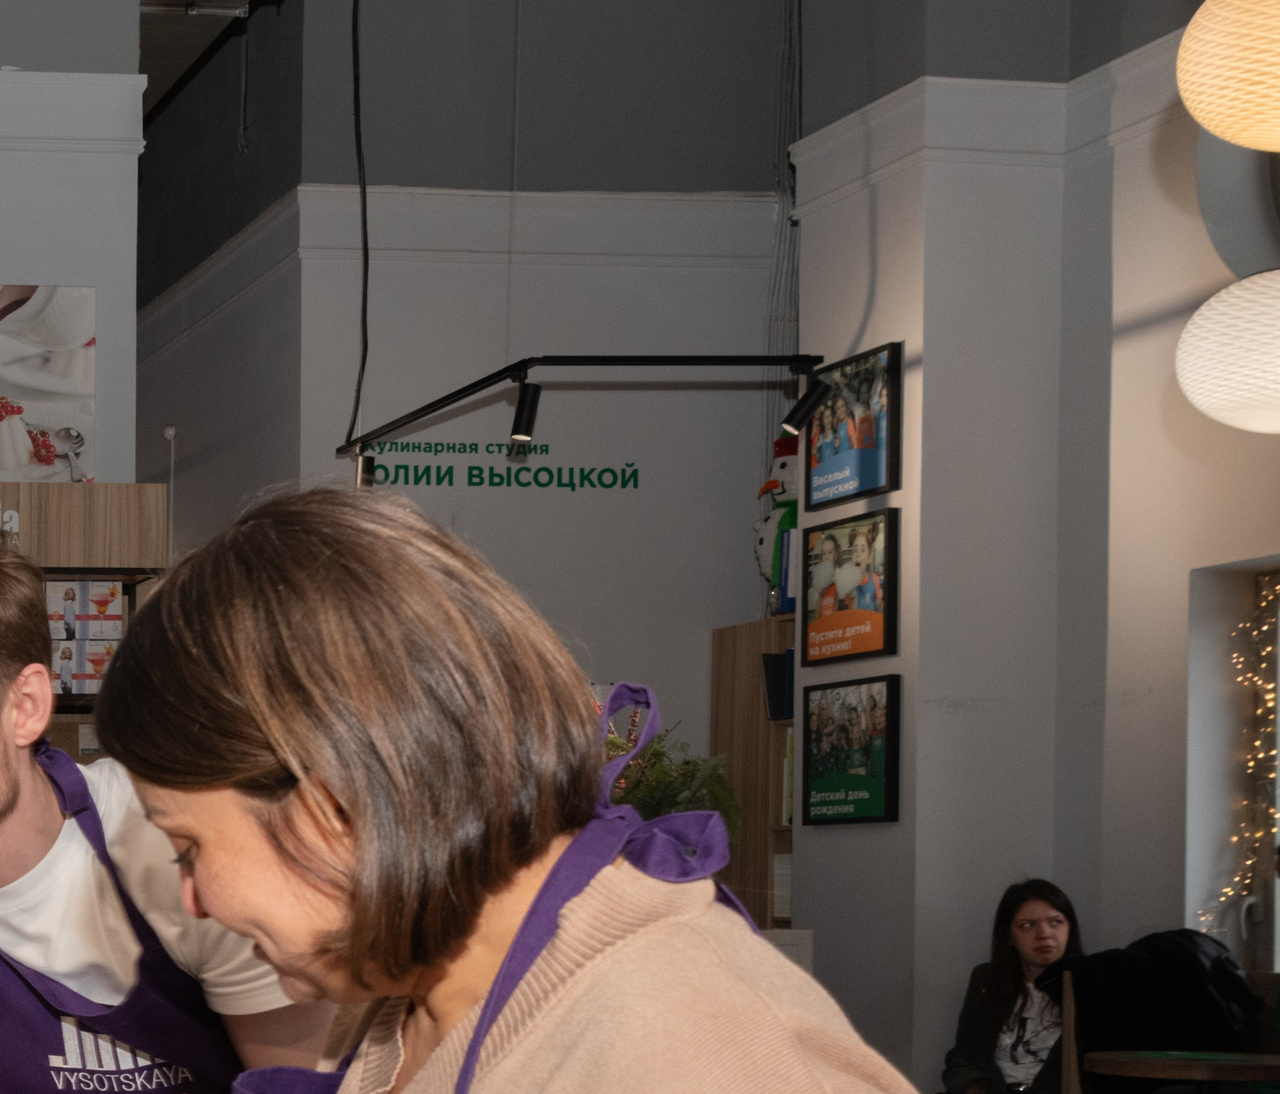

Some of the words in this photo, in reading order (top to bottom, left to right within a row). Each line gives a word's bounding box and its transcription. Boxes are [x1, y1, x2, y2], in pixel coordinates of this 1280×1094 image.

[485, 441, 549, 457] студия
[467, 463, 639, 492] ВЫСОЦКОЙ
[809, 629, 843, 645] Пустите
[845, 621, 872, 638] детей
[810, 788, 846, 803] Детский
[847, 790, 870, 801] день
[810, 804, 854, 817] рождения
[50, 1065, 194, 1092] VYSOTSKAYA
